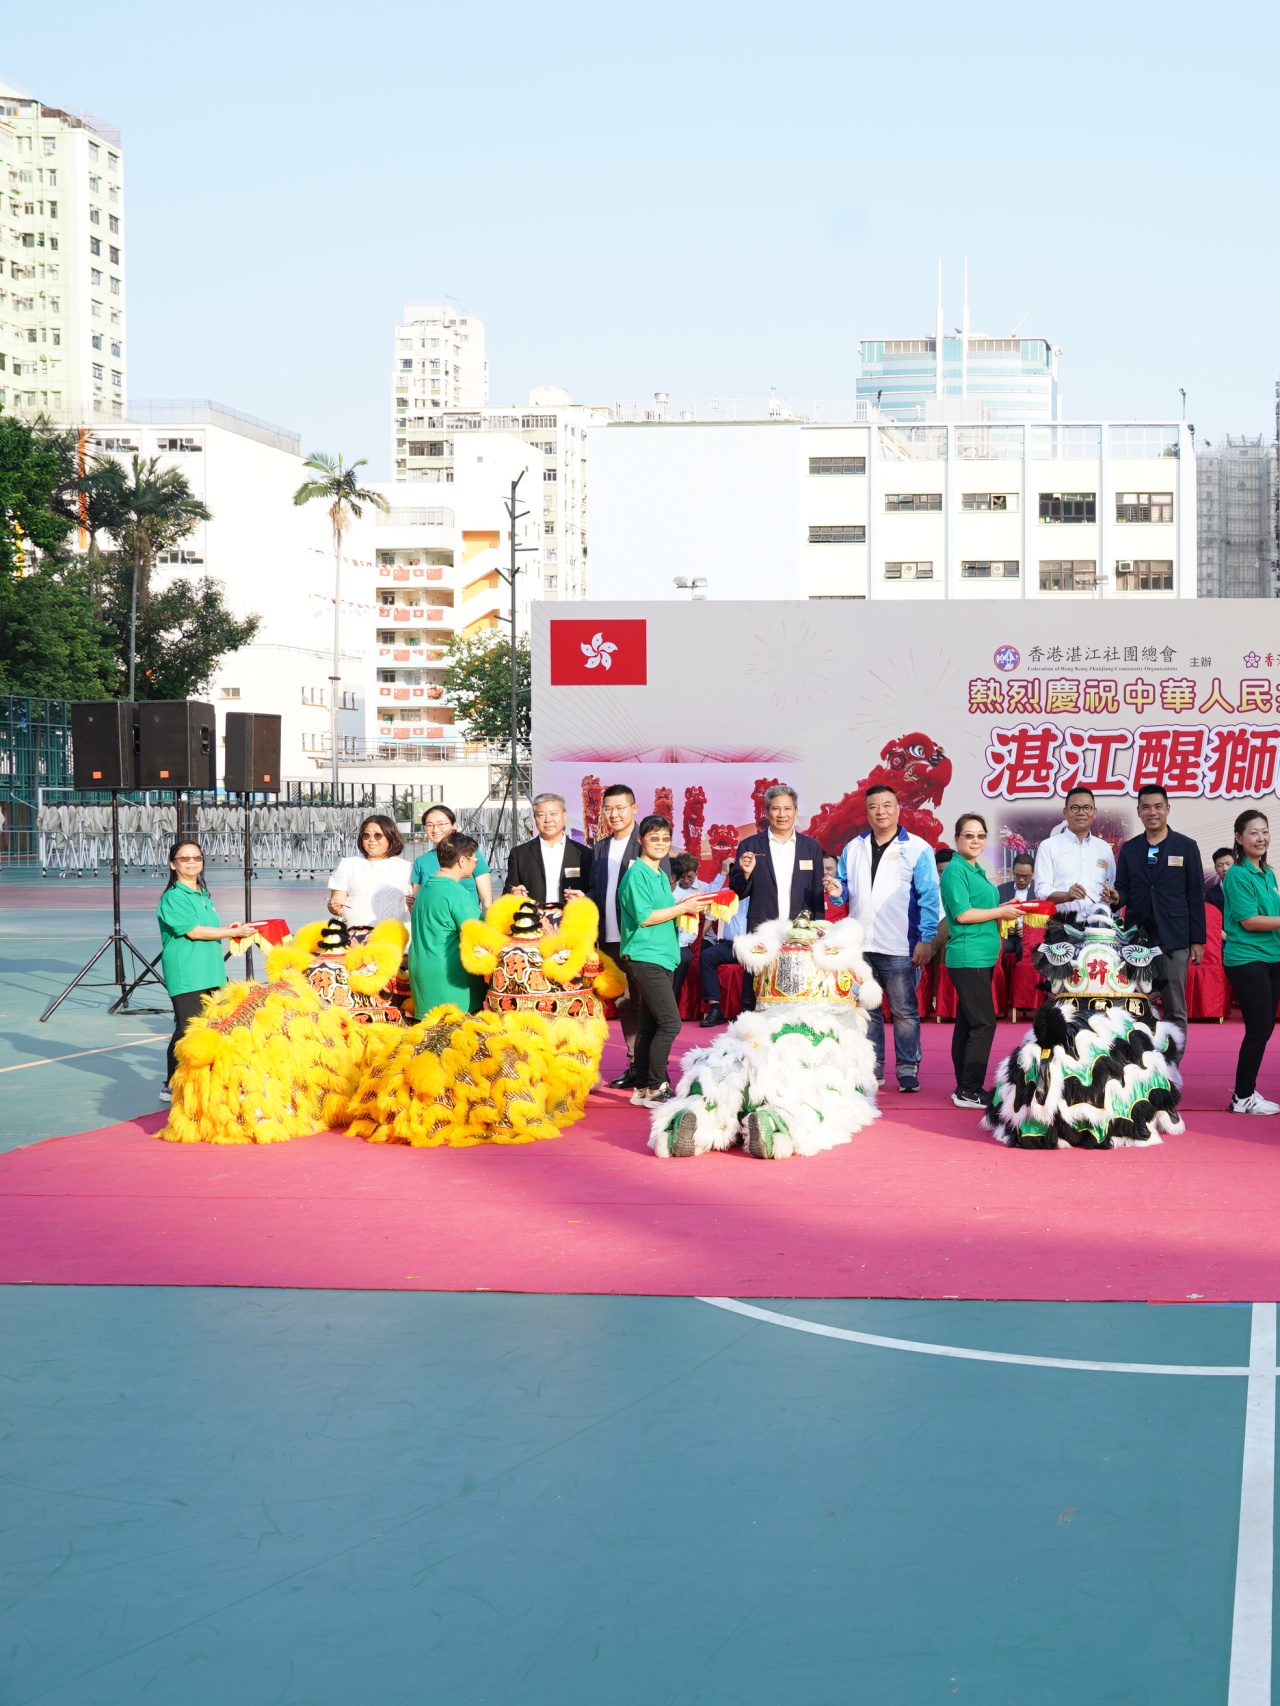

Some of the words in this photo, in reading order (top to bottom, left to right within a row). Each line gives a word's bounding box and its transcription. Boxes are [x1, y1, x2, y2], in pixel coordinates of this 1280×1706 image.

[1028, 646, 1177, 663] 香港湛江社團總會
[1190, 656, 1212, 668] 主辦
[1087, 959, 1110, 986] 許
